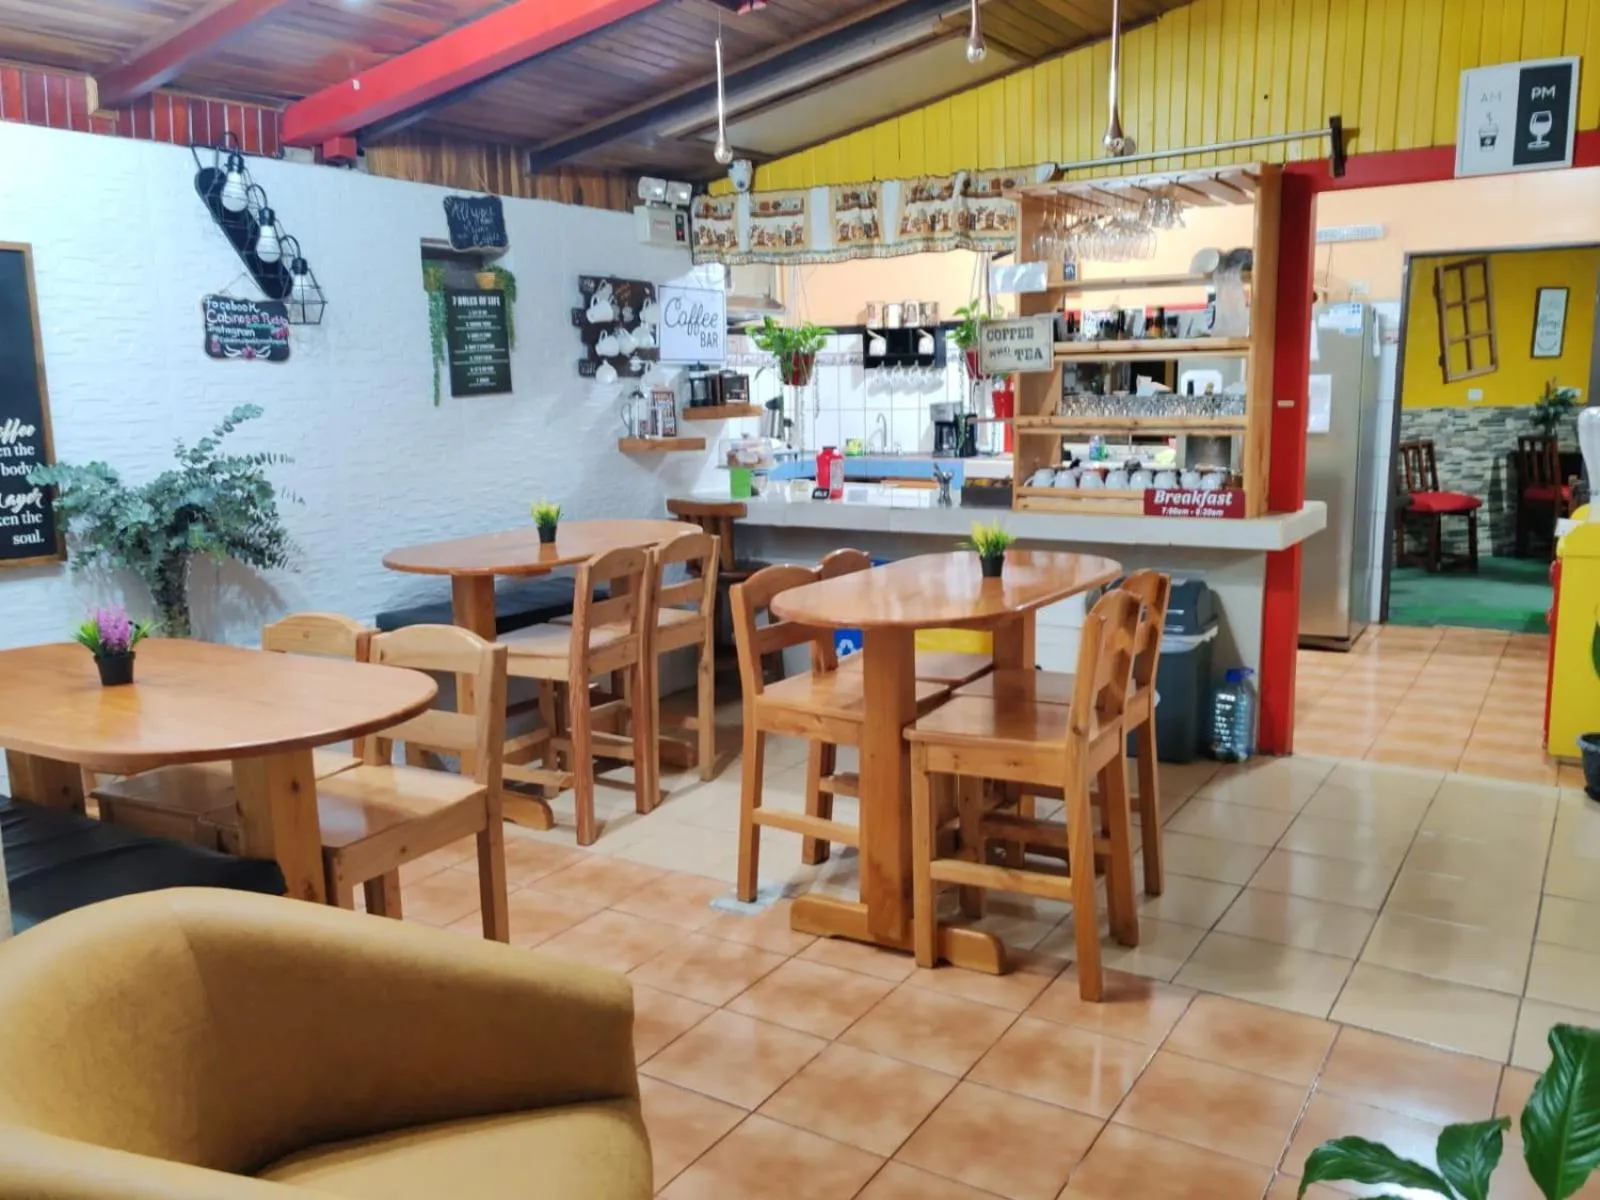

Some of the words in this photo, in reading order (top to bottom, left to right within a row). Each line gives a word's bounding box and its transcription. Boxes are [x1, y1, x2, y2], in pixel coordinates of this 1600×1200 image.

[1480, 91, 1502, 103] AM
[1531, 85, 1556, 101] PM
[664, 297, 719, 336] Coffee
[700, 331, 719, 348] BAR
[986, 326, 1034, 343] COFFEE
[1014, 347, 1044, 361] TEA
[13, 441, 35, 457] the
[1153, 489, 1233, 508] Breakfast
[20, 510, 44, 525] the
[13, 529, 45, 546] soul.
